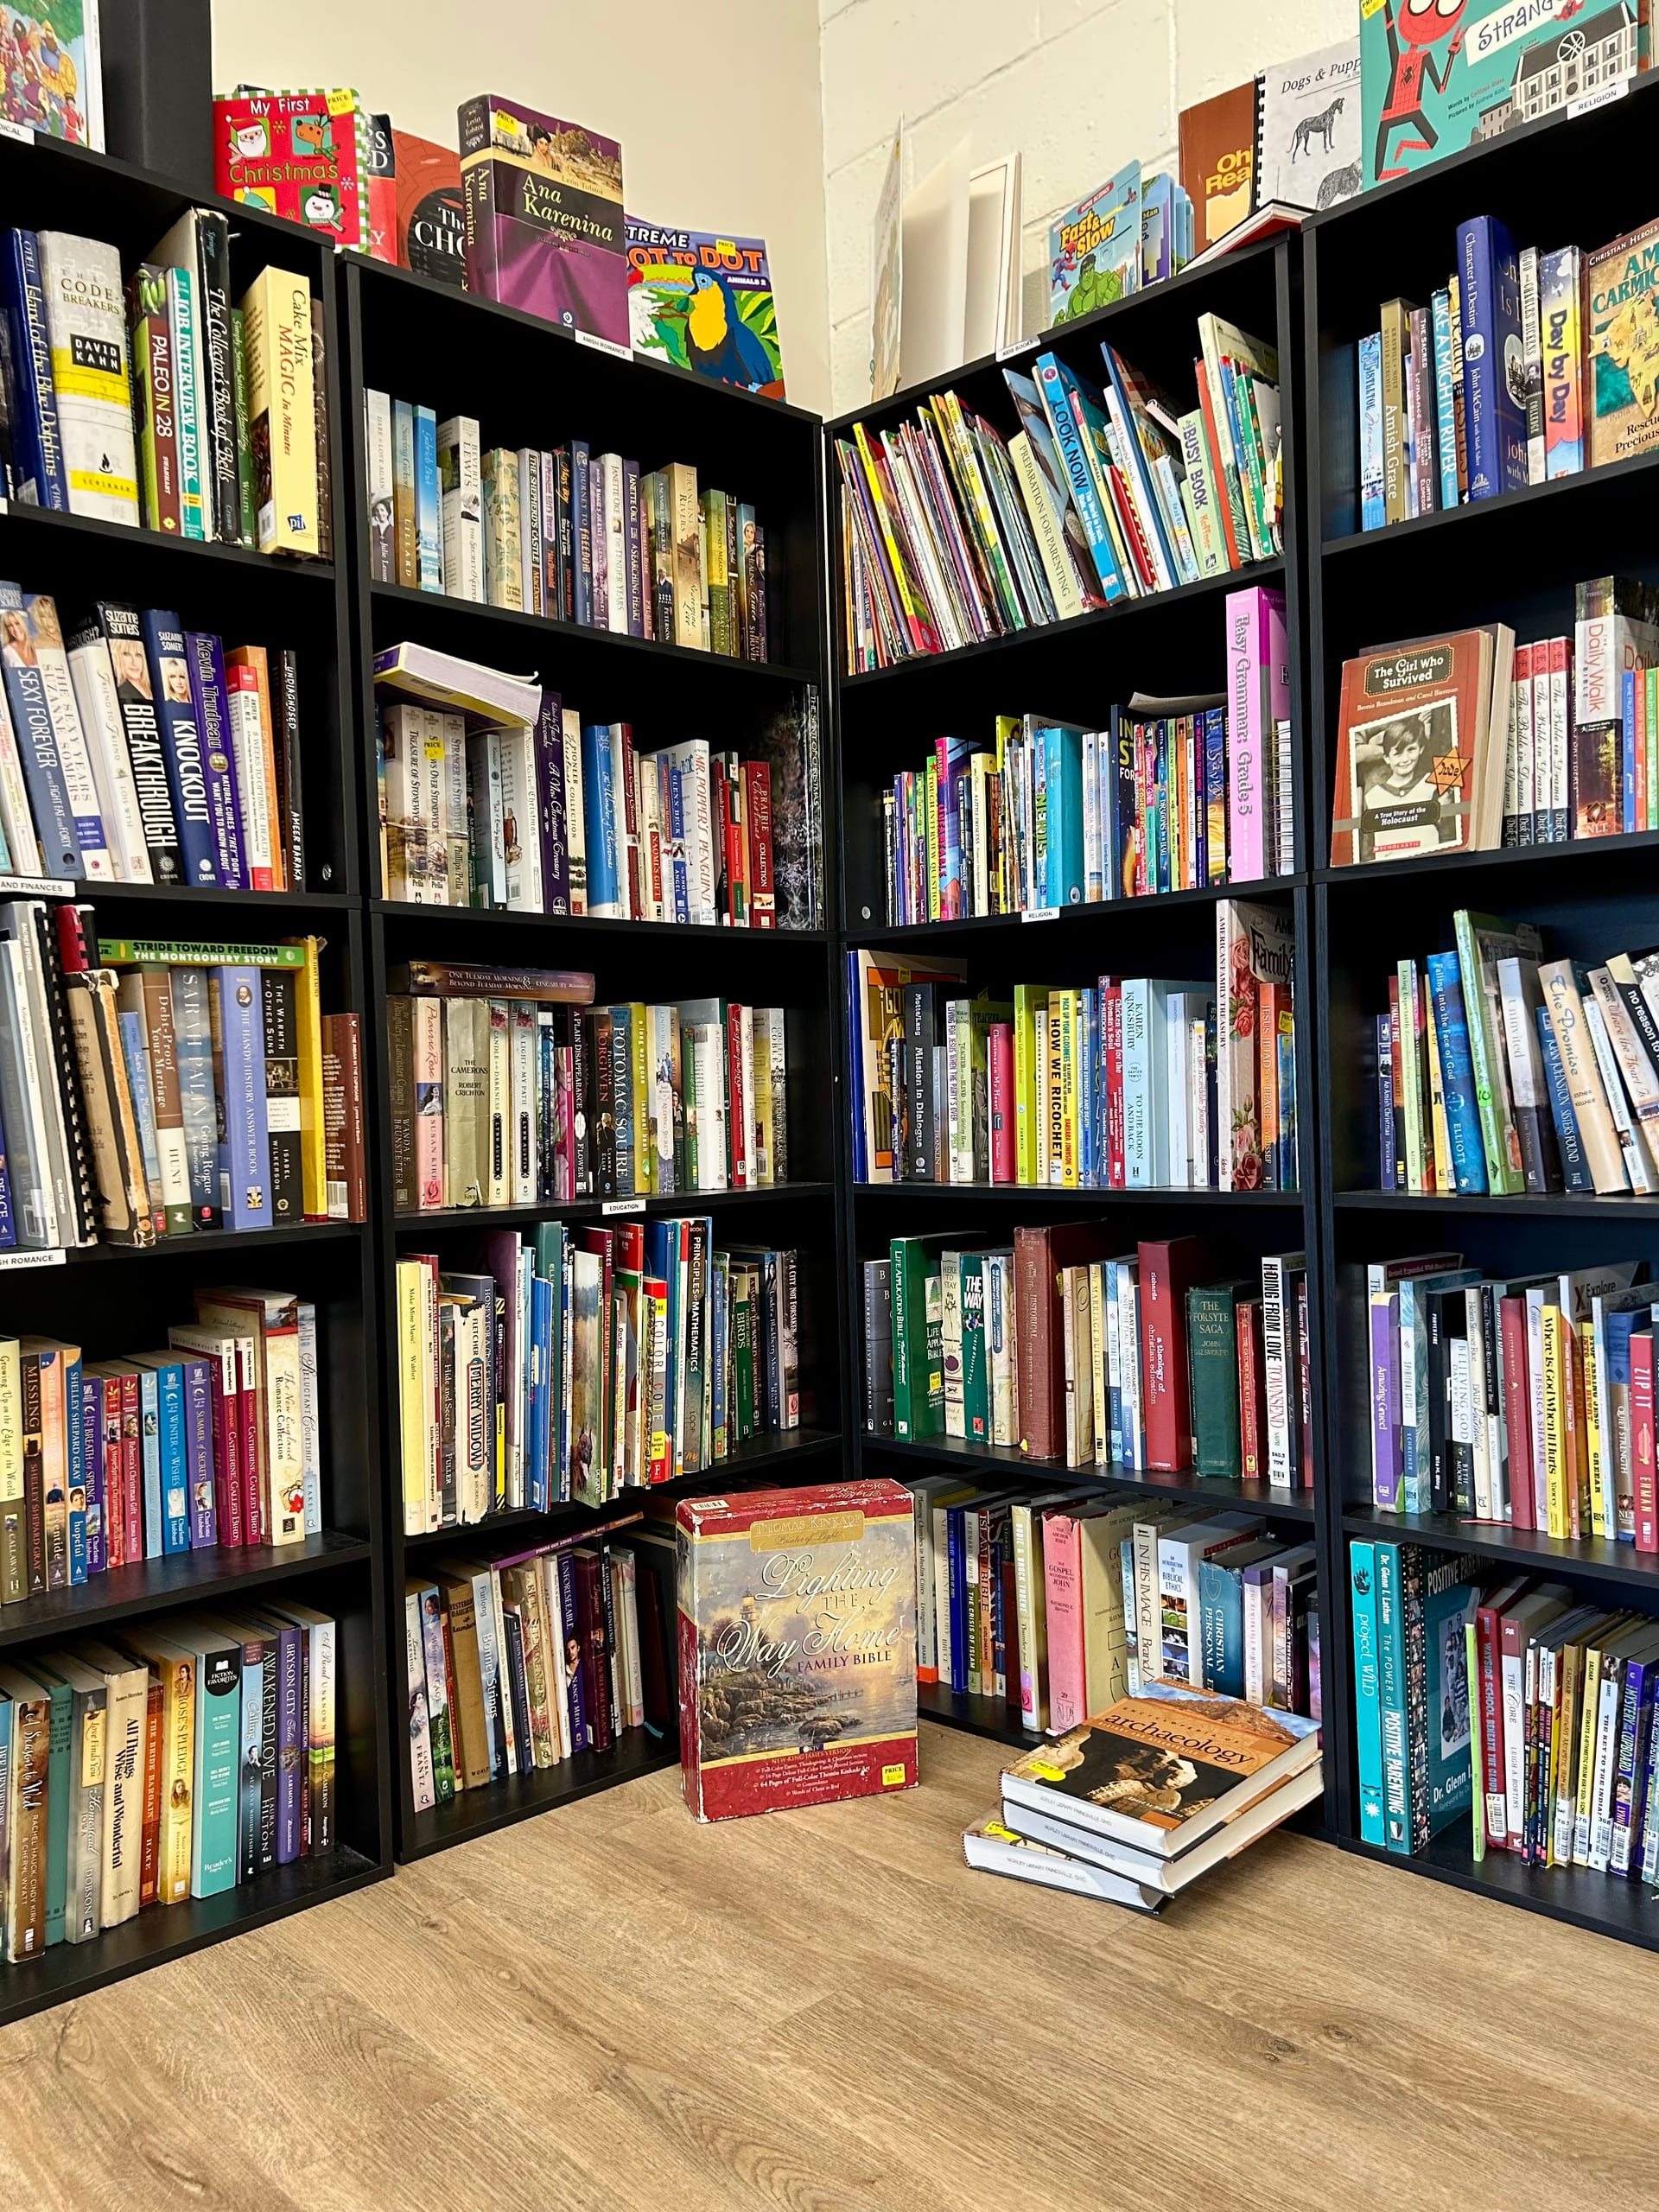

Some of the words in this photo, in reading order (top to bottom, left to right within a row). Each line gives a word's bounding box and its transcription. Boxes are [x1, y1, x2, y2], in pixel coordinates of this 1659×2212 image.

[1281, 72, 1311, 94] Dogs
[1315, 67, 1326, 80] &
[1329, 58, 1362, 76] Pupp
[250, 99, 270, 116] My
[278, 98, 310, 112] First
[1578, 89, 1617, 111] RELIGION
[228, 163, 339, 184] Christmas
[522, 175, 562, 203] Ana
[524, 194, 613, 242] Karenina
[625, 225, 689, 249] TREME
[1061, 209, 1094, 249] Fast
[1093, 214, 1101, 230] &
[1076, 219, 1116, 259] Slow
[1590, 243, 1626, 265] CHRISTIAN
[1630, 227, 1656, 244] HEROES
[626, 247, 669, 269] OT
[673, 252, 696, 266] TO
[699, 246, 763, 272] DOT
[60, 280, 119, 301] CODE-
[62, 294, 119, 315] BREAKERS
[291, 289, 306, 329] Cake
[74, 338, 117, 358] DAVID
[295, 332, 308, 366] Mix
[582, 335, 600, 347] AMISH
[600, 340, 626, 355] ROMANCE
[1002, 347, 1016, 356] KIDS
[1017, 340, 1034, 352] BOOKS
[1548, 309, 1567, 351] Day
[76, 353, 118, 371] KAHN
[152, 334, 169, 392] PALEO
[279, 323, 295, 396] MAGIC
[1548, 353, 1569, 379] by
[156, 394, 171, 412] IN
[282, 397, 289, 410] In
[1549, 383, 1569, 423] Day
[156, 413, 173, 437] 28
[282, 410, 291, 456] Minutes
[1386, 404, 1398, 449] Amish
[1052, 401, 1078, 447] LOOK
[1066, 449, 1088, 489] NOW
[1184, 427, 1201, 466] BUSY
[462, 442, 472, 487] LEWIS
[1020, 443, 1045, 514] PREPARATION
[1388, 453, 1397, 499] Grace
[1191, 468, 1209, 510] BOOK
[1041, 515, 1052, 534] FOR
[1046, 532, 1070, 599] PARENTING
[1230, 614, 1249, 652] Easy
[1587, 623, 1604, 664] Daily
[1374, 665, 1393, 678] The
[1395, 658, 1419, 676] Girl
[1421, 655, 1444, 668] Who
[1383, 670, 1433, 690] Survived
[17, 669, 40, 707] SEXY
[287, 665, 296, 729] UNDIAGNOSED
[1233, 655, 1251, 744] Grammar:
[1589, 670, 1606, 712] Walk
[27, 709, 58, 768] FOREVER
[123, 703, 178, 849] BREAKTHROUGH
[172, 720, 210, 823] KNOCKOUT
[1236, 748, 1251, 799] Grade
[696, 753, 709, 835] MR.POPPER'S
[1240, 804, 1253, 816] 5
[291, 810, 300, 844] AMEER
[1381, 814, 1418, 826] Holocaust
[294, 844, 302, 880] BARAKA
[652, 834, 661, 874] NAOMI'S
[697, 838, 711, 904] PENGUINS
[21, 882, 63, 892] FINANCES
[133, 942, 173, 951] STRIDE
[176, 944, 225, 954] TOWARD
[228, 946, 278, 956] FREEDOM
[134, 951, 157, 960] THE
[160, 952, 239, 963] MONTGOMERY
[243, 955, 278, 964] STORY
[182, 975, 203, 1046] SARAH
[1127, 991, 1135, 1051] KINGSBURY
[1549, 975, 1566, 1010] The
[1558, 1009, 1579, 1076] Promise
[1050, 1018, 1060, 1048] HOW
[613, 1027, 626, 1112] POTOMAC
[1051, 1053, 1061, 1079] WE
[188, 1053, 207, 1122] PALIN
[1052, 1087, 1062, 1160] RICOCHET
[616, 1119, 629, 1178] SQUIRE
[1454, 1123, 1465, 1164] ELLIOTT
[272, 1141, 281, 1190] WILKERSON
[10, 1255, 54, 1265] ROMANCE
[964, 1292, 983, 1308] WAY
[965, 1275, 982, 1292] THE
[1263, 1263, 1279, 1300] HIDING
[1586, 1281, 1616, 1298] Explore
[1192, 1312, 1229, 1323] FORSYTE
[1201, 1301, 1219, 1311] THE
[1265, 1302, 1281, 1334] FROM
[690, 1302, 700, 1372] MATHEMATICS
[736, 1313, 745, 1348] BIRDS
[1199, 1324, 1224, 1333] SAGA
[1267, 1336, 1281, 1362] LOVE
[472, 1366, 481, 1405] MERRY
[1268, 1365, 1284, 1429] TOWNSEND
[1635, 1367, 1649, 1389] ZIP
[1636, 1396, 1650, 1408] IT
[472, 1408, 481, 1466] WIDOW
[1640, 1477, 1651, 1512] EHMAN
[73, 1521, 84, 1558] hopeful
[1140, 1543, 1150, 1558] IN
[754, 1554, 901, 1614] Lighting
[1141, 1561, 1151, 1583] HIS
[563, 1560, 574, 1630] UNFORESEEABLE
[822, 1595, 858, 1610] THE
[1141, 1585, 1152, 1626] IMAGE
[481, 1634, 493, 1675] Bonnet
[716, 1614, 801, 1679] Way
[802, 1607, 900, 1656] Home
[1216, 1609, 1225, 1674] CHRISTIAN
[1357, 1612, 1372, 1661] project
[207, 1675, 237, 1686] FAVORITES
[211, 1670, 234, 1679] FICTION
[286, 1643, 295, 1683] BRYSON
[798, 1656, 849, 1673] FAMILY
[853, 1652, 892, 1665] BIBLE
[1362, 1662, 1375, 1697] WILD
[263, 1650, 276, 1735] AWAKENED
[287, 1685, 296, 1714] CITY
[486, 1678, 497, 1719] Strings
[1104, 1713, 1255, 1764] archaeology
[1384, 1710, 1402, 1758] POSITIVE
[262, 1737, 275, 1779] LOVE
[1387, 1757, 1405, 1815] PARENTING
[262, 1799, 271, 1851] HILTON
